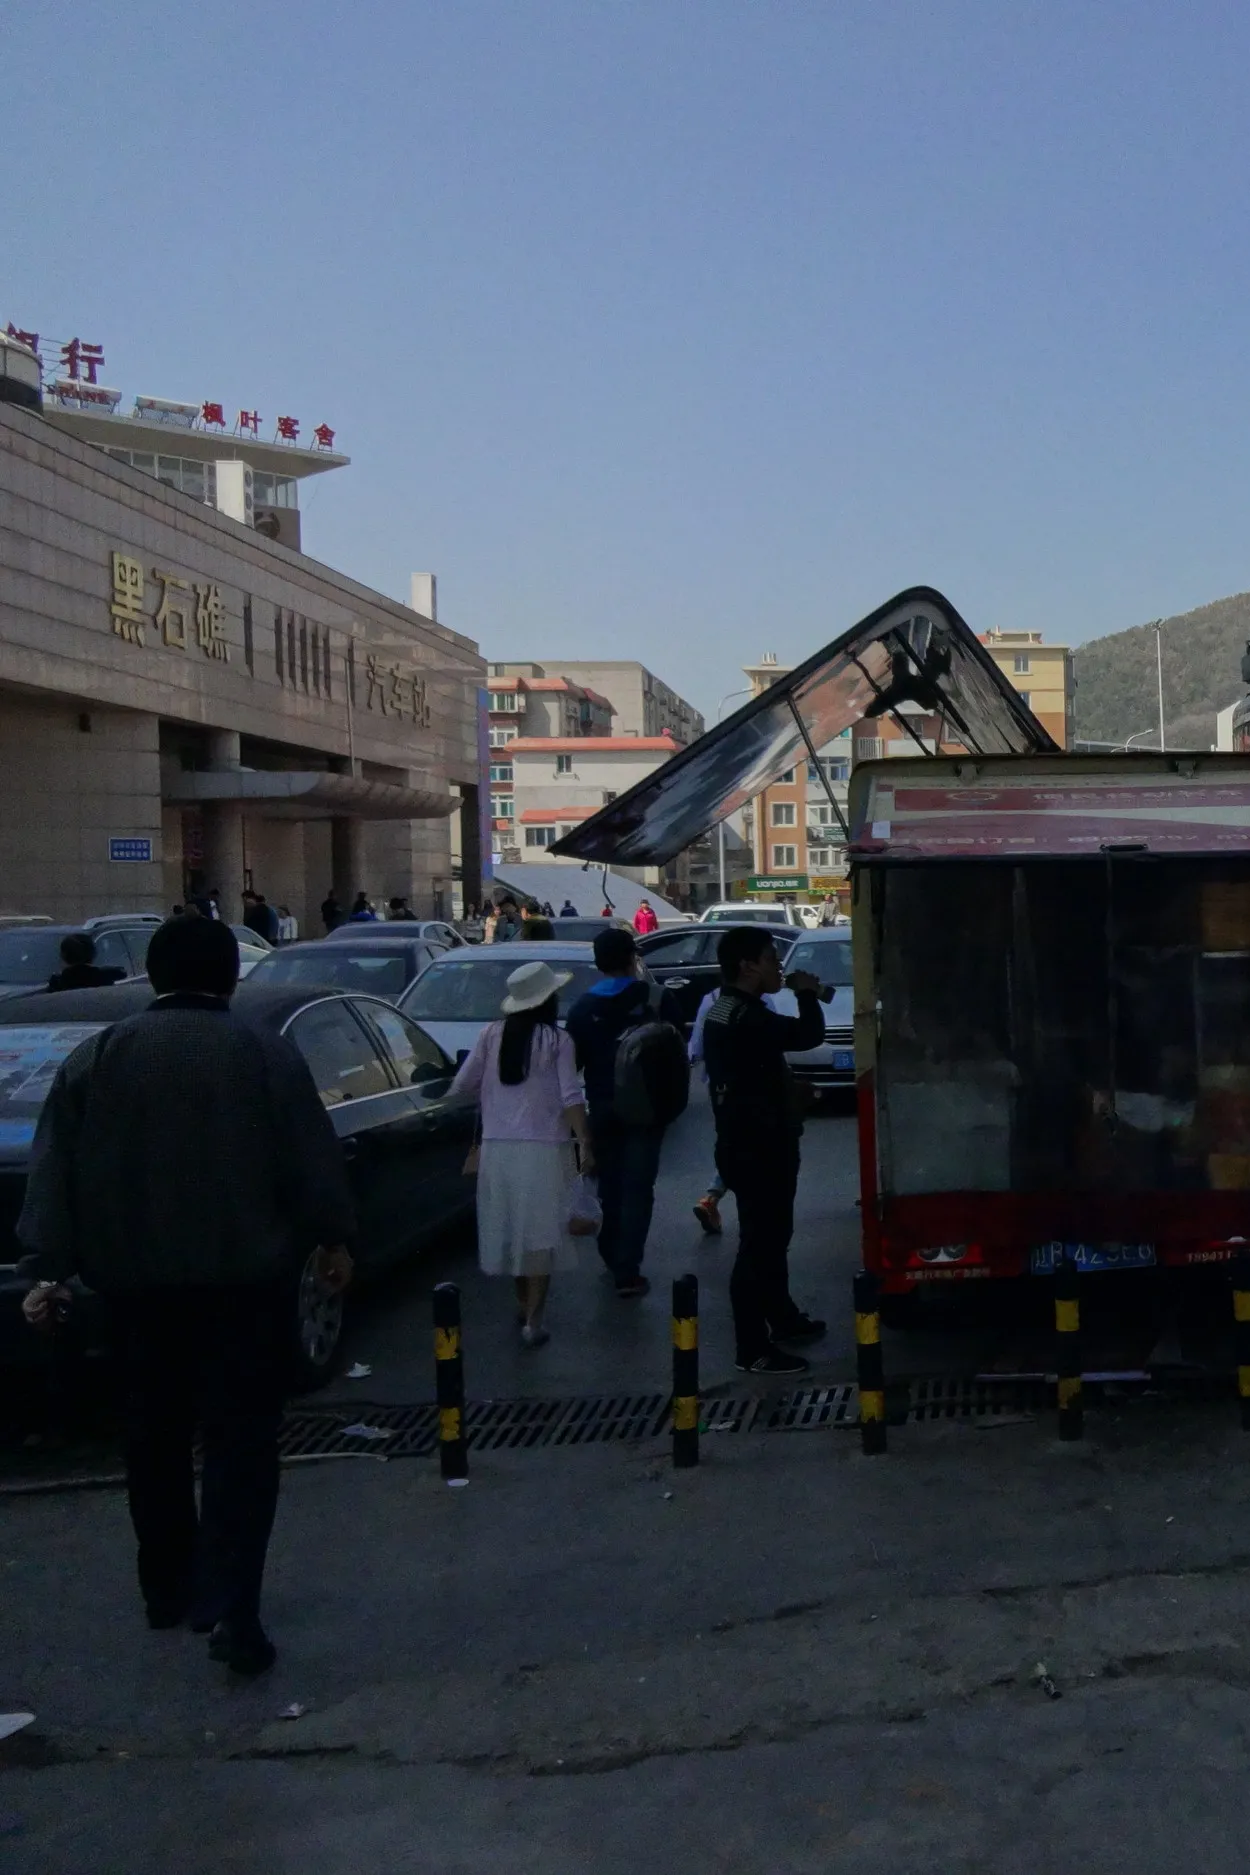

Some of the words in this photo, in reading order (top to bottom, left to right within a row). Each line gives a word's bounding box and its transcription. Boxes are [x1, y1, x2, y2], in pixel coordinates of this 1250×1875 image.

[109, 551, 231, 664] 黑石礁
[367, 654, 430, 730] 汽车站
